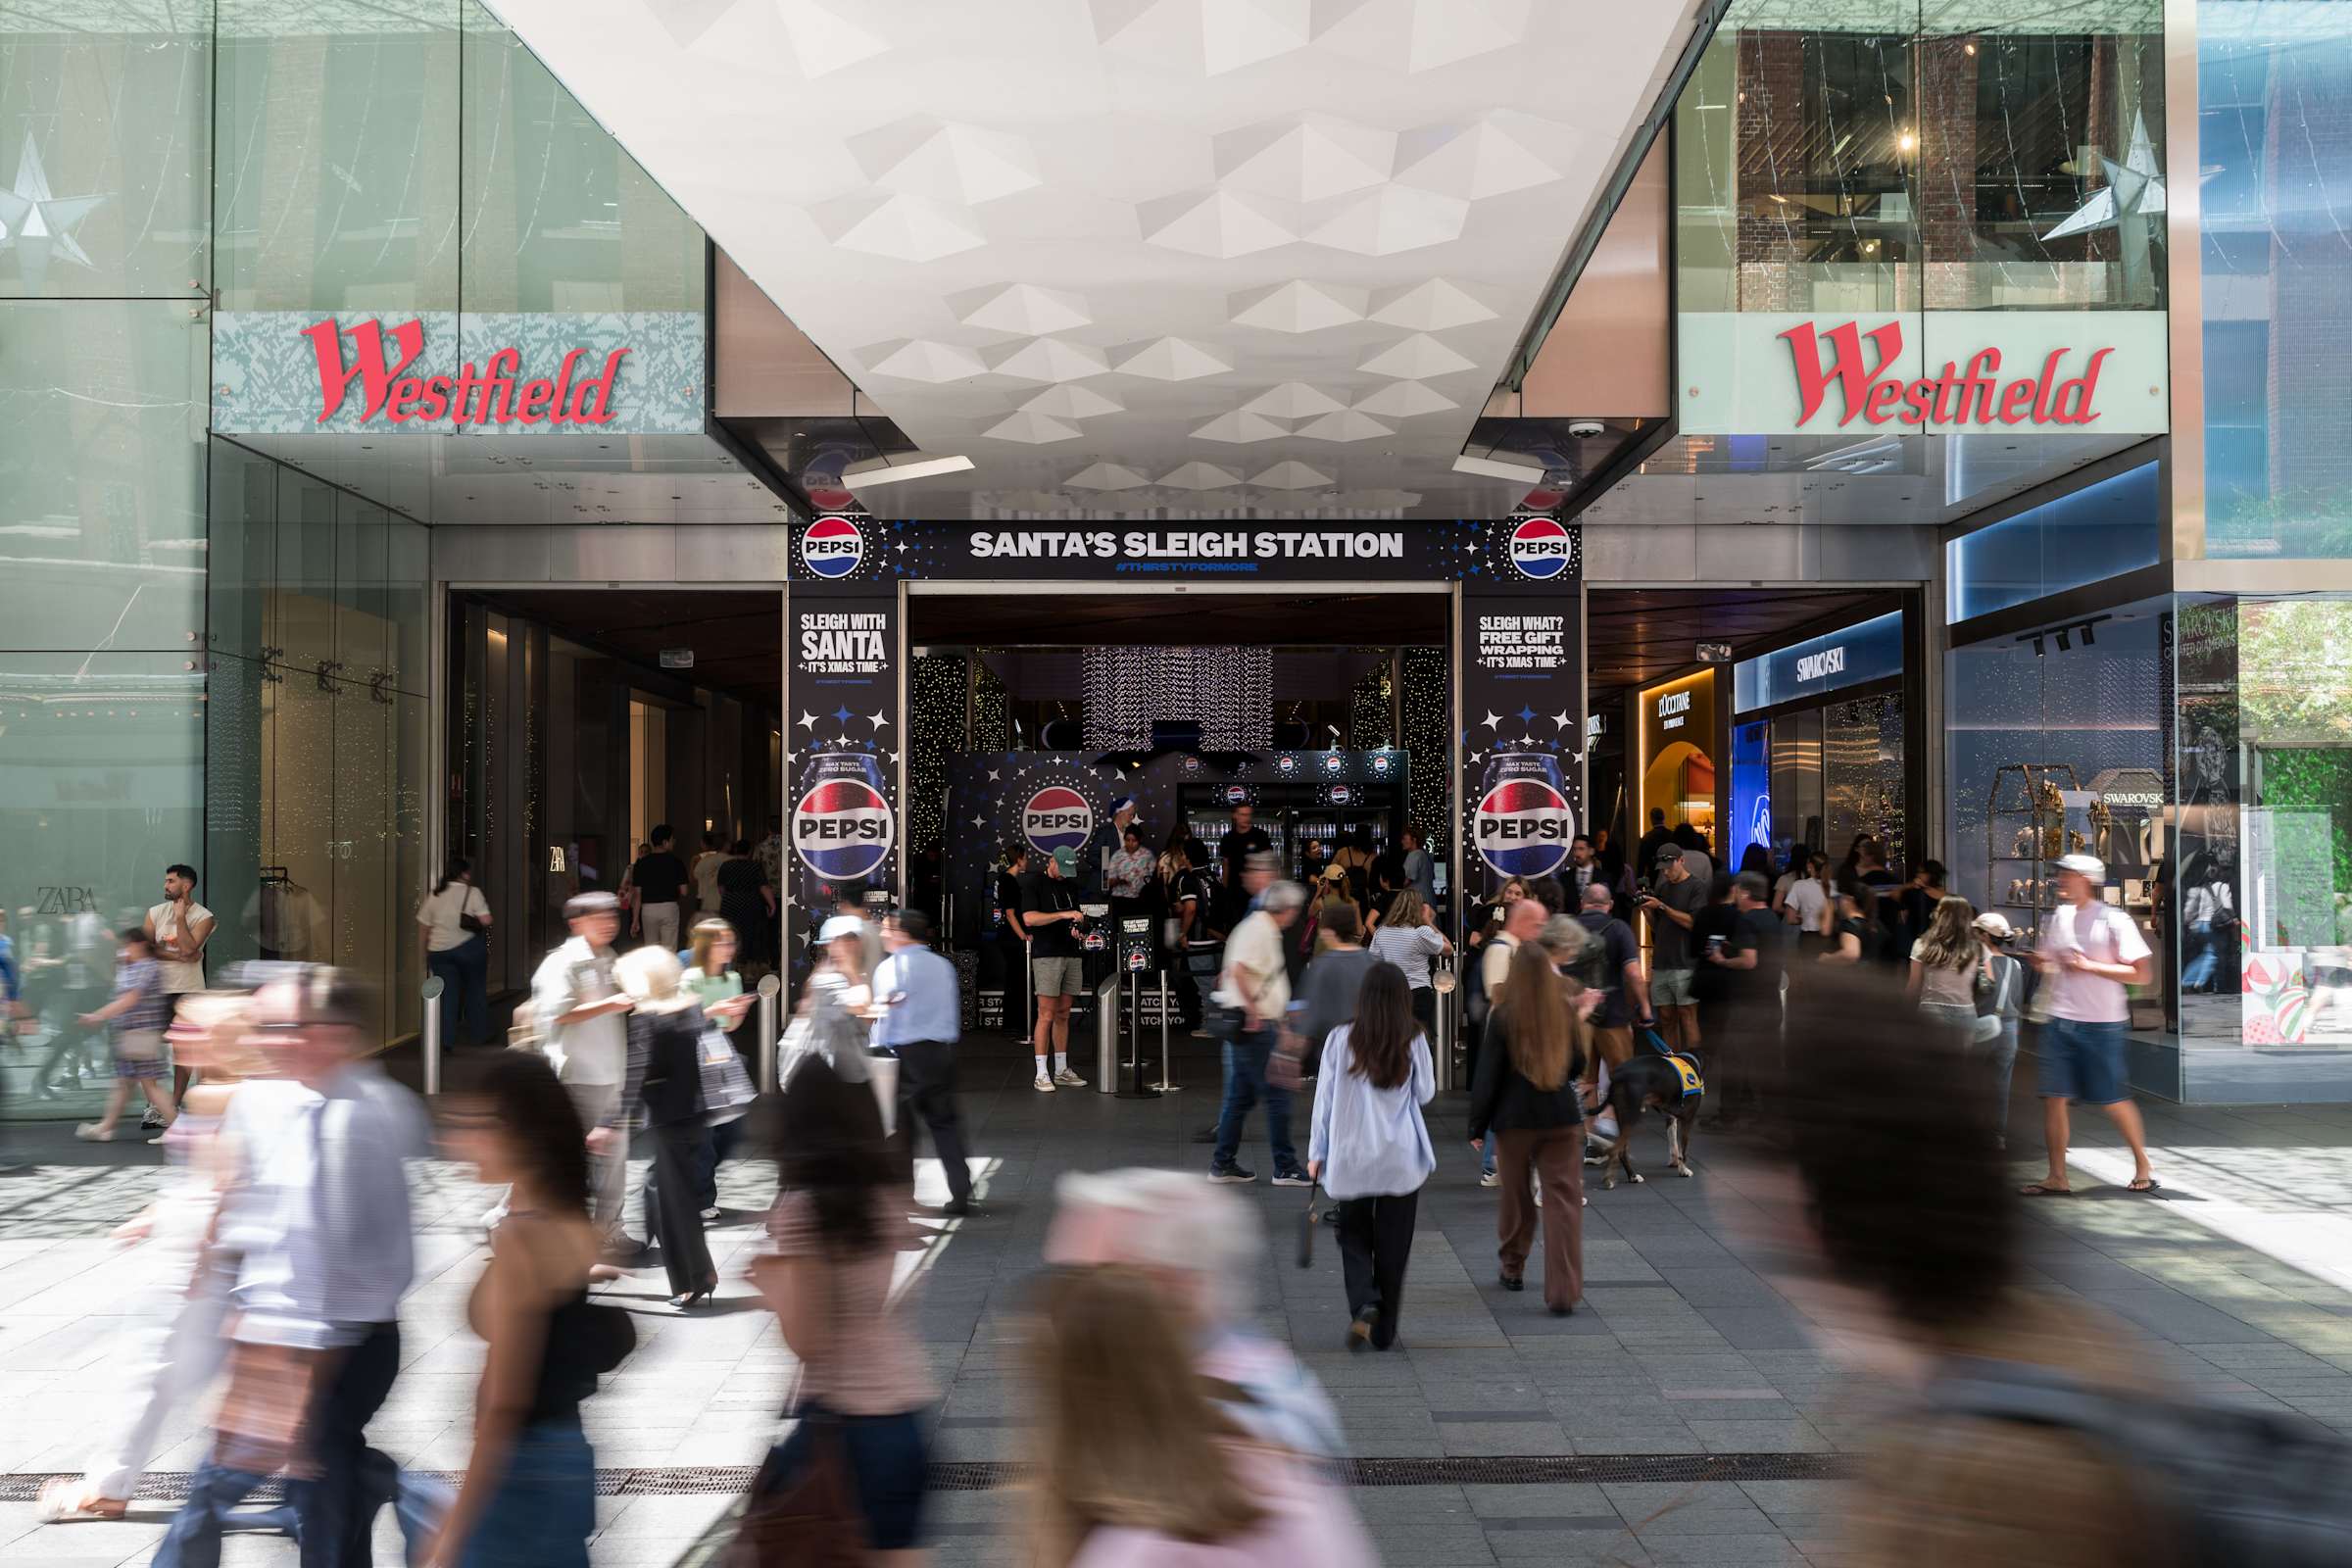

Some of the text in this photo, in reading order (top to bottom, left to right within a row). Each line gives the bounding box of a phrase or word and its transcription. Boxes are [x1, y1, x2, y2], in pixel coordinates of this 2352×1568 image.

[300, 318, 633, 425] Westfield
[1776, 319, 2115, 427] Westfield
[807, 541, 859, 554] PEPSI
[970, 531, 1403, 558] SANTA'S SLEIGH STATION
[1514, 542, 1567, 555] PEPSI
[1115, 562, 1258, 572] #THIRSTYFORMORE
[801, 613, 886, 630] SLEIGH WITH
[1479, 616, 1564, 630] SLEIGH WHAT?
[2164, 607, 2235, 643] SAROVSKI
[1480, 631, 1564, 645] FREE GIFT
[802, 630, 886, 661] SANTA
[1480, 645, 1564, 655] WRAPPING
[808, 662, 879, 673] IT'S XMAS TIME
[1487, 656, 1557, 668] IT'S XMAS TIME
[2103, 793, 2164, 804] SWAROVSK
[1027, 814, 1088, 828] PEPSI
[799, 819, 887, 839] PEPSI
[1480, 818, 1568, 839] PEPSI
[37, 886, 102, 915] ZARA
